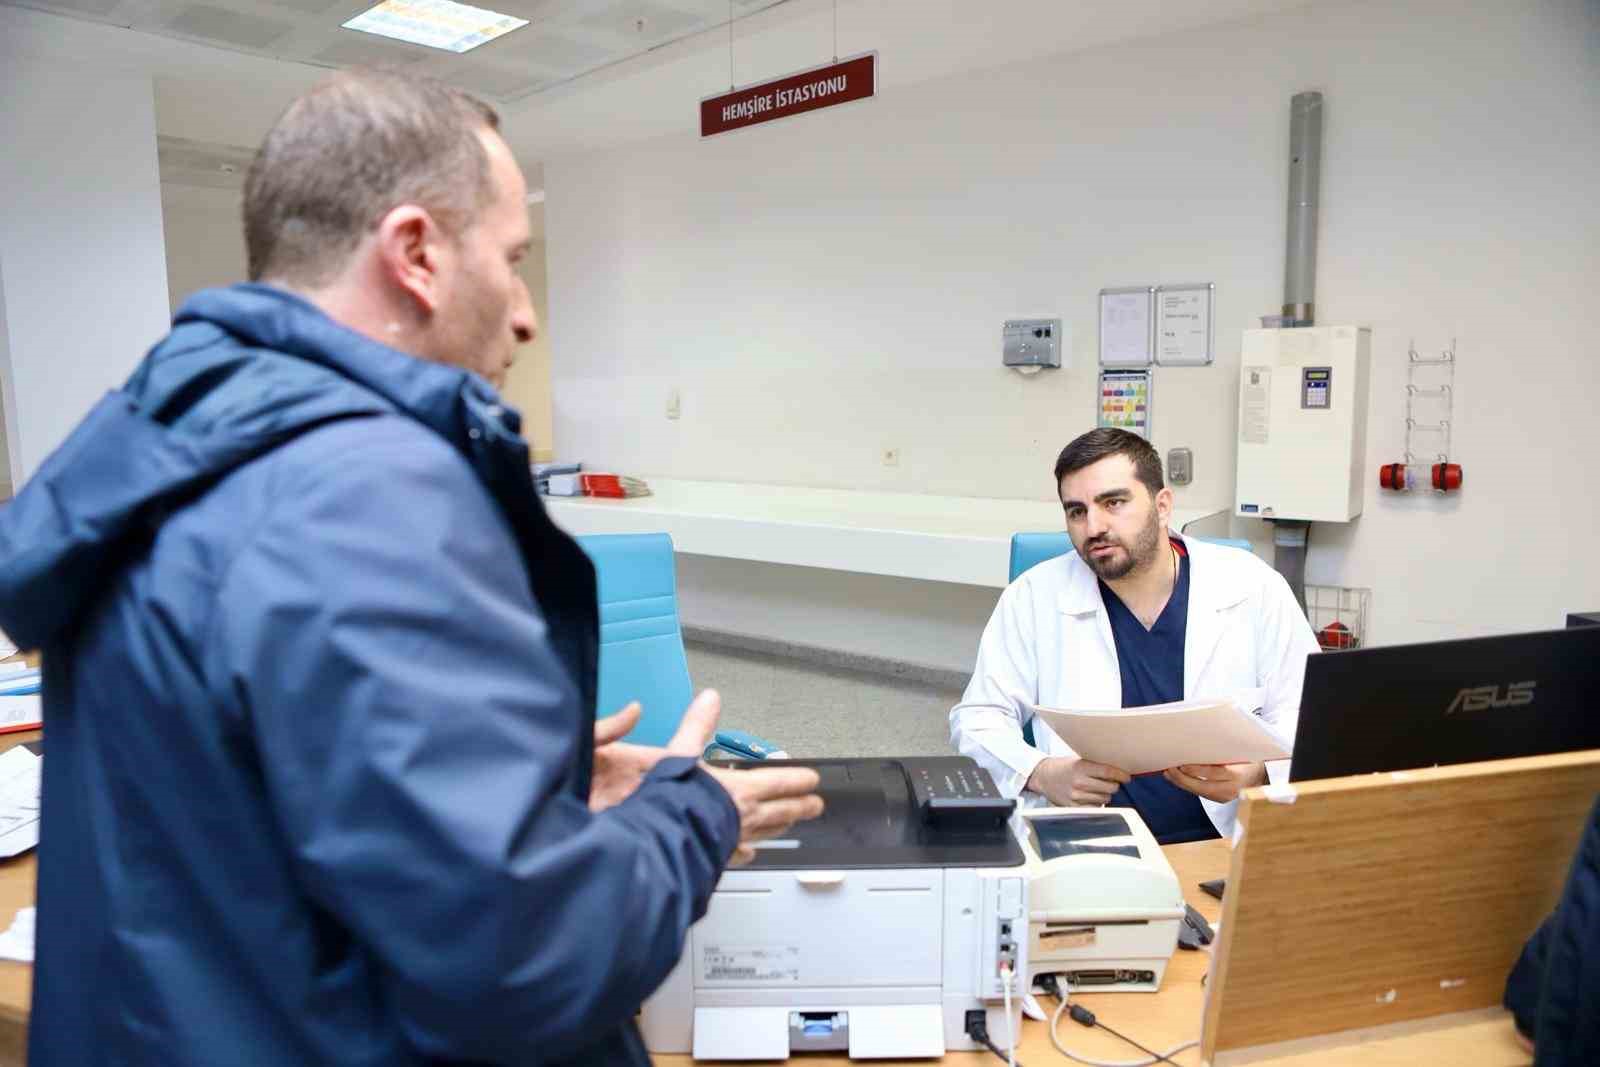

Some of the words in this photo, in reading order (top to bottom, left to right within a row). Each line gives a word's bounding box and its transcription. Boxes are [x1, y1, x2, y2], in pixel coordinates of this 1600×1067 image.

[722, 95, 773, 121] HEMŞİRE
[776, 75, 847, 108] İSTASYONU
[1447, 680, 1536, 713] ASUS
